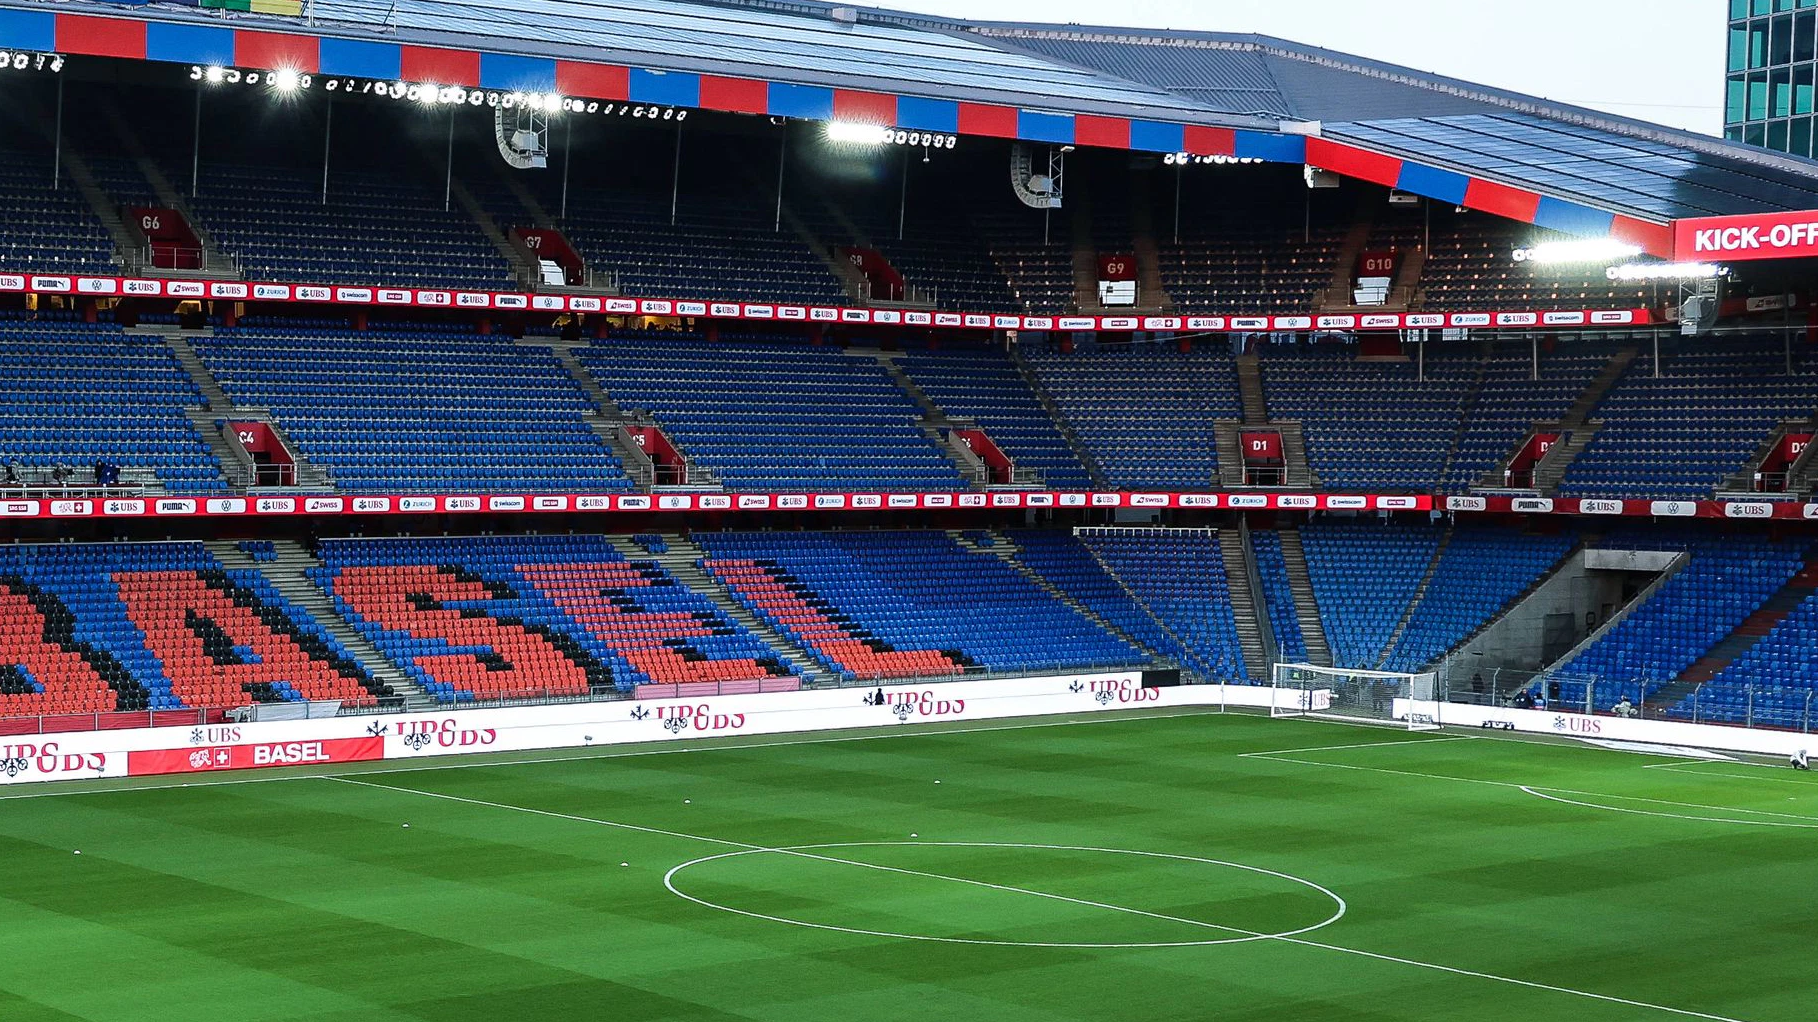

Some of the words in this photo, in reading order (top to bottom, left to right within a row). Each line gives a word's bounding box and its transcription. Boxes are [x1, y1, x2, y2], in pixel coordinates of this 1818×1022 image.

[142, 216, 160, 229] G6
[1107, 262, 1125, 274] G9
[1366, 257, 1393, 271] G10
[136, 283, 154, 291] UBS
[1252, 440, 1268, 451] D1
[121, 503, 137, 511] UBS
[270, 501, 288, 509] UBS
[1463, 500, 1479, 508] UBS
[1597, 502, 1615, 511] UBS
[1742, 506, 1765, 515] UBS
[1569, 717, 1601, 733] UBS
[208, 726, 241, 743] UBS
[254, 742, 330, 766] BASEL
